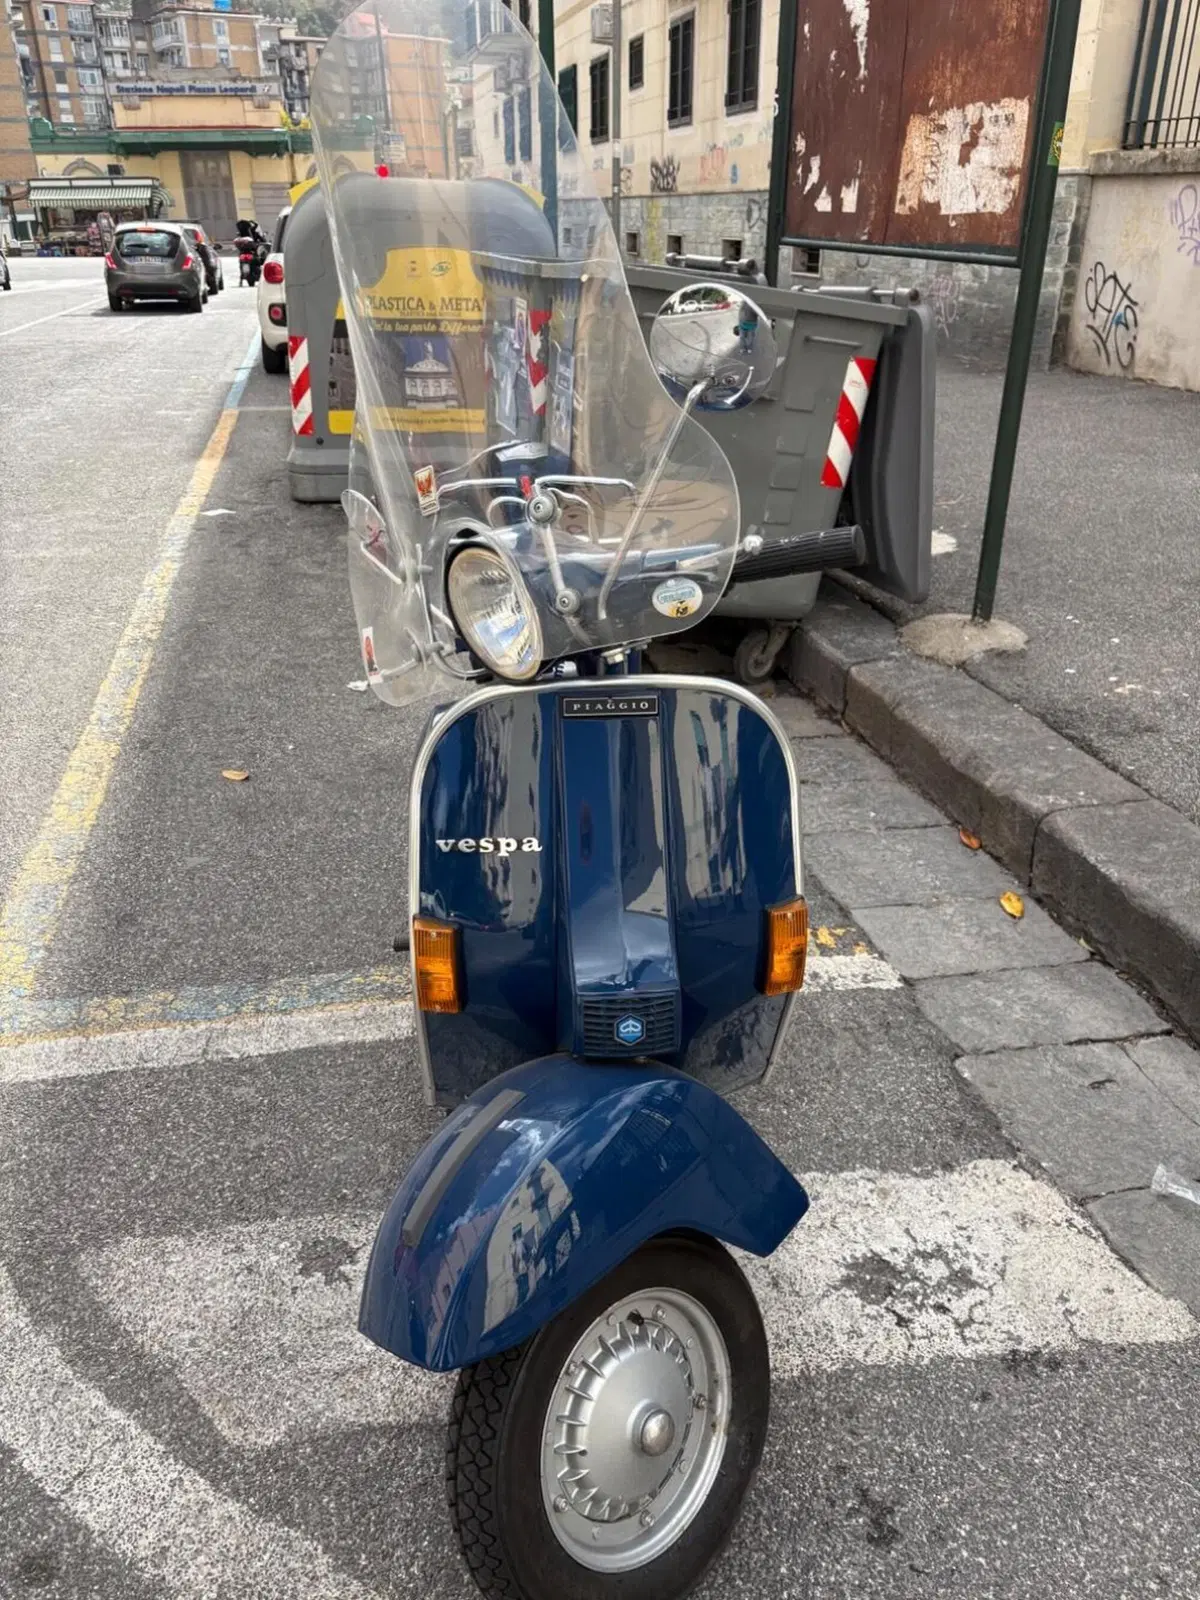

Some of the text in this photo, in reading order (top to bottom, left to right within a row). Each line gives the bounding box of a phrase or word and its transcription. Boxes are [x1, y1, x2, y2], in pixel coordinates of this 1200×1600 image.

[116, 85, 257, 95] Stazione Napoli Piazza Leopardi
[440, 296, 485, 311] META
[573, 701, 649, 711] PIAGGIO
[435, 837, 543, 857] vespa
